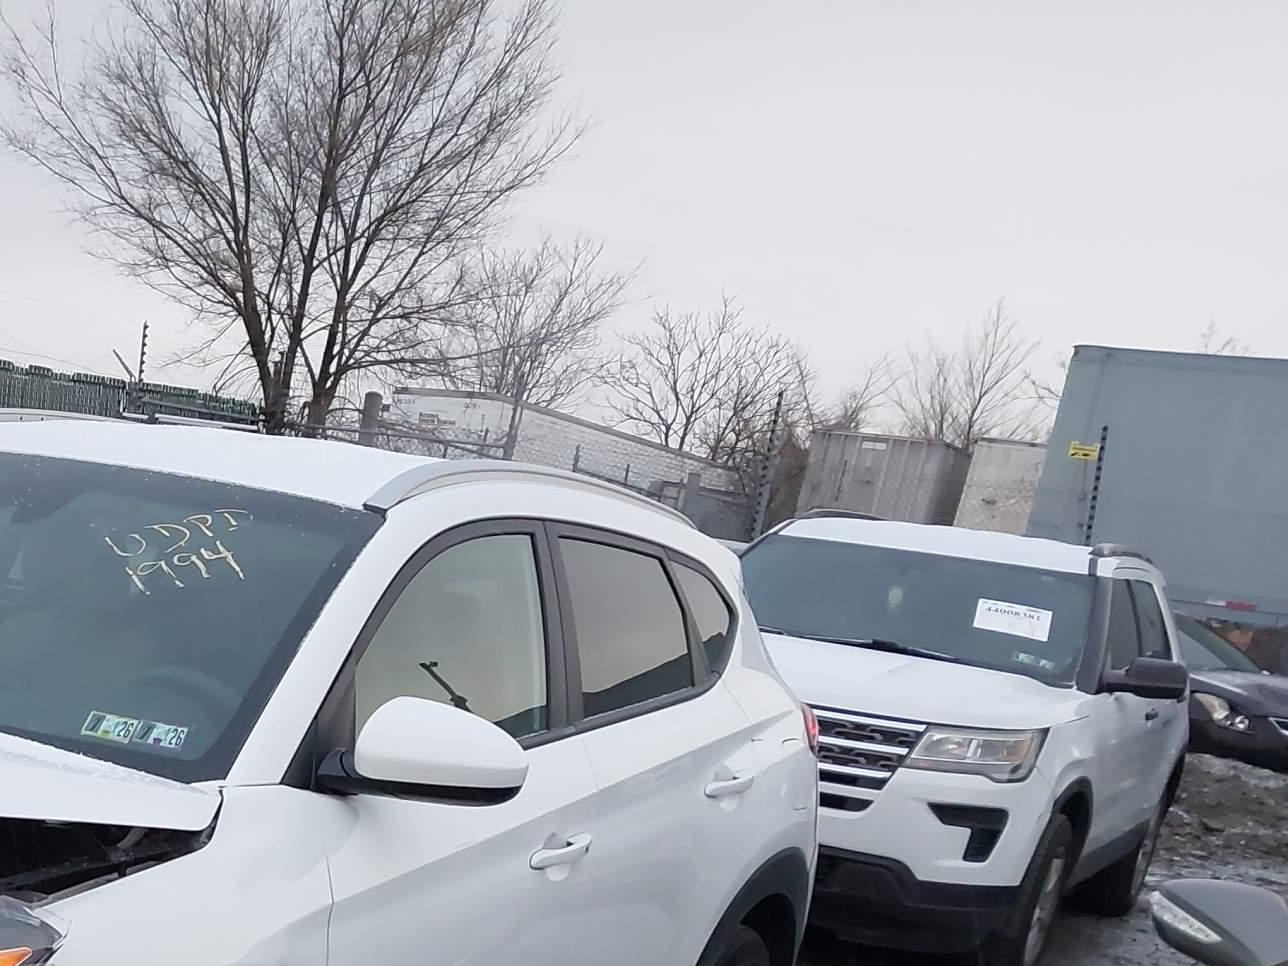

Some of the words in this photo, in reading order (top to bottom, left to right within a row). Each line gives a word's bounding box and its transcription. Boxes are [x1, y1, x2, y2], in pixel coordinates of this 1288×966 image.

[125, 540, 245, 595] 1994
[117, 720, 134, 739] 26
[168, 728, 185, 746] 26
